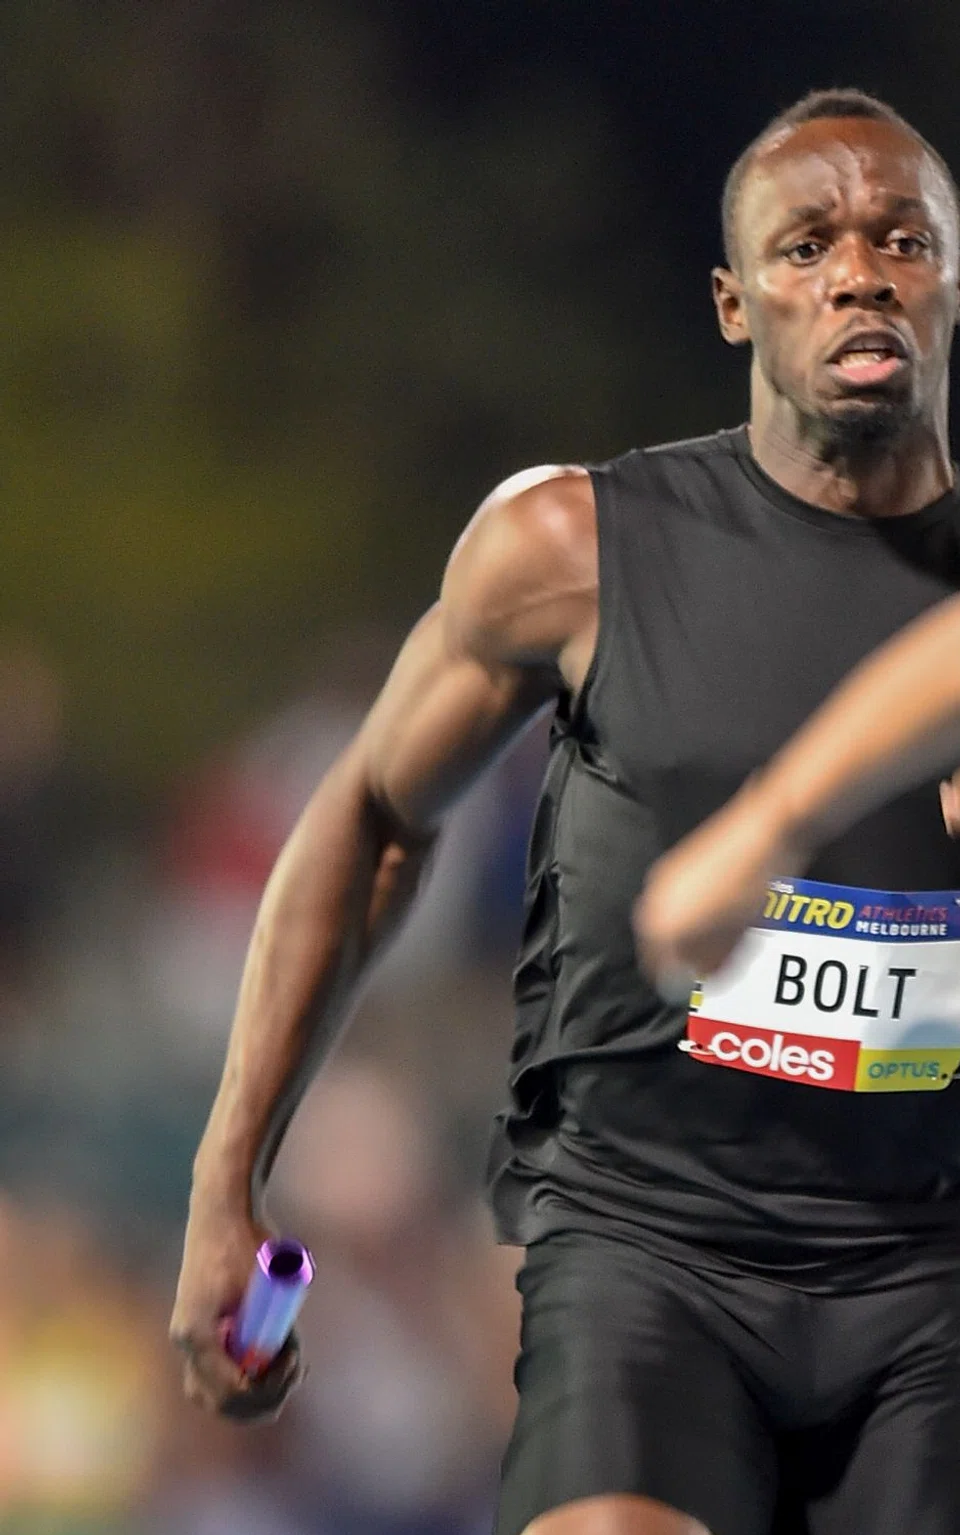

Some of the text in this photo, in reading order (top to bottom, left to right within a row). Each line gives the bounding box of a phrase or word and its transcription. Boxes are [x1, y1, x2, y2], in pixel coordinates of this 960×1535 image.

[855, 920, 948, 936] MELBOURNE
[774, 953, 918, 1020] BOLT
[711, 1031, 836, 1081] coles
[867, 1061, 939, 1080] OPTUS
